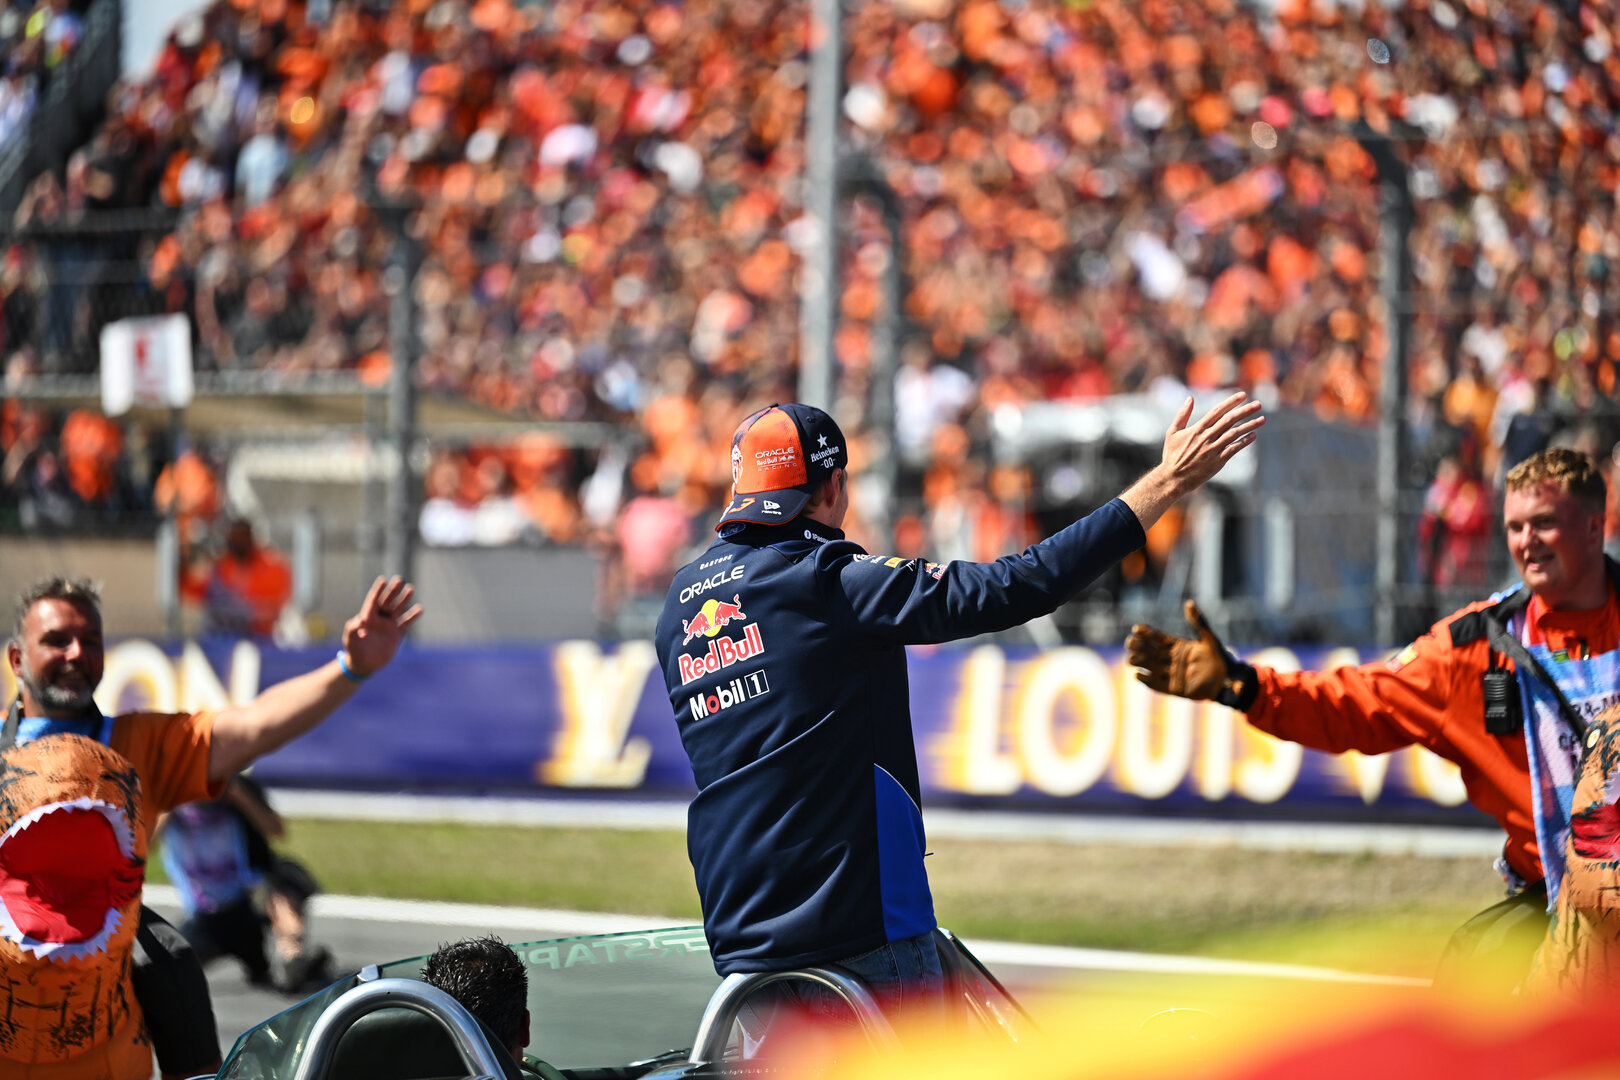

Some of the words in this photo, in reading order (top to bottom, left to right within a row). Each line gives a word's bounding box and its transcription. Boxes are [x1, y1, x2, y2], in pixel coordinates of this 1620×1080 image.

[755, 446, 794, 459] ORACLE
[810, 446, 840, 463] Heineken
[679, 565, 745, 604] ORACLE
[678, 639, 720, 686] Red
[717, 622, 765, 668] Bull
[689, 678, 746, 721] Mobil
